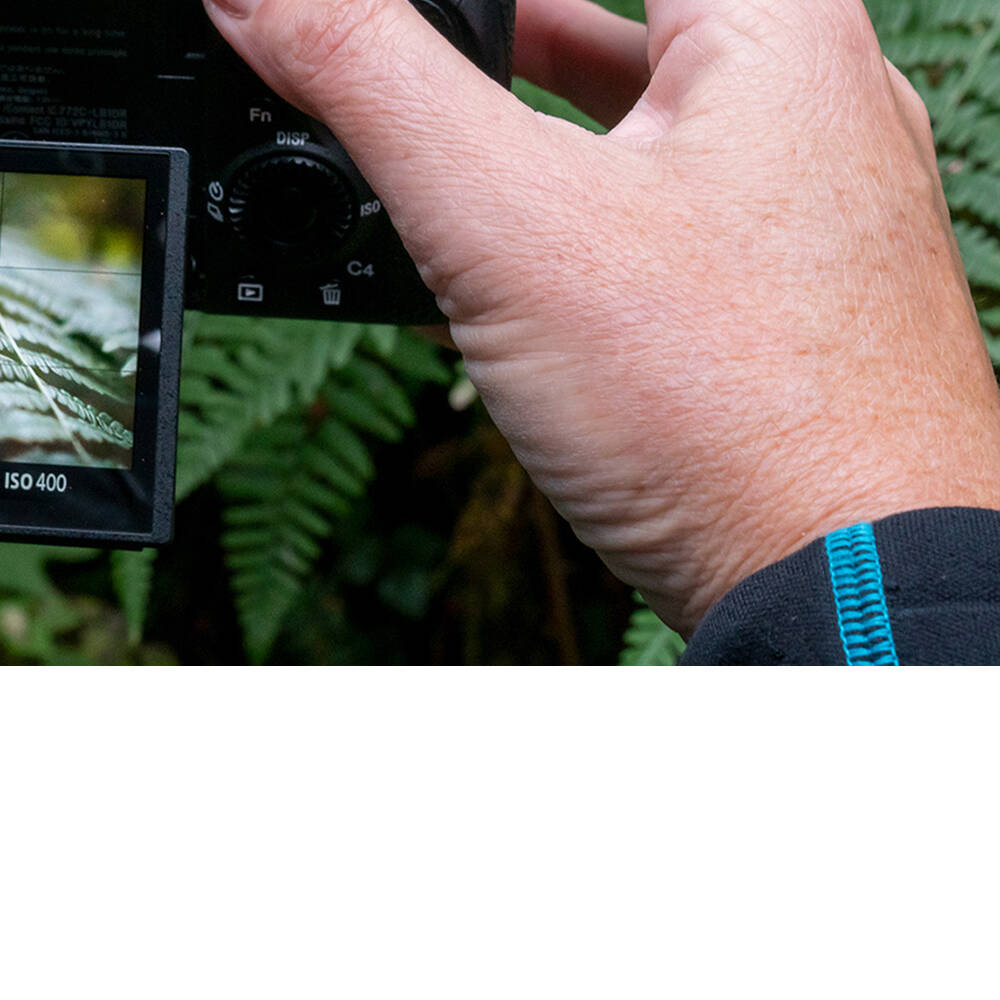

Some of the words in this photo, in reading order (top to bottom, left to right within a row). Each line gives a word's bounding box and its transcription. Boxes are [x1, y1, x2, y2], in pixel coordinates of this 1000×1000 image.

[249, 108, 272, 123] Fn
[276, 131, 310, 146] DISP
[360, 200, 381, 217] ISO
[346, 260, 374, 277] C4
